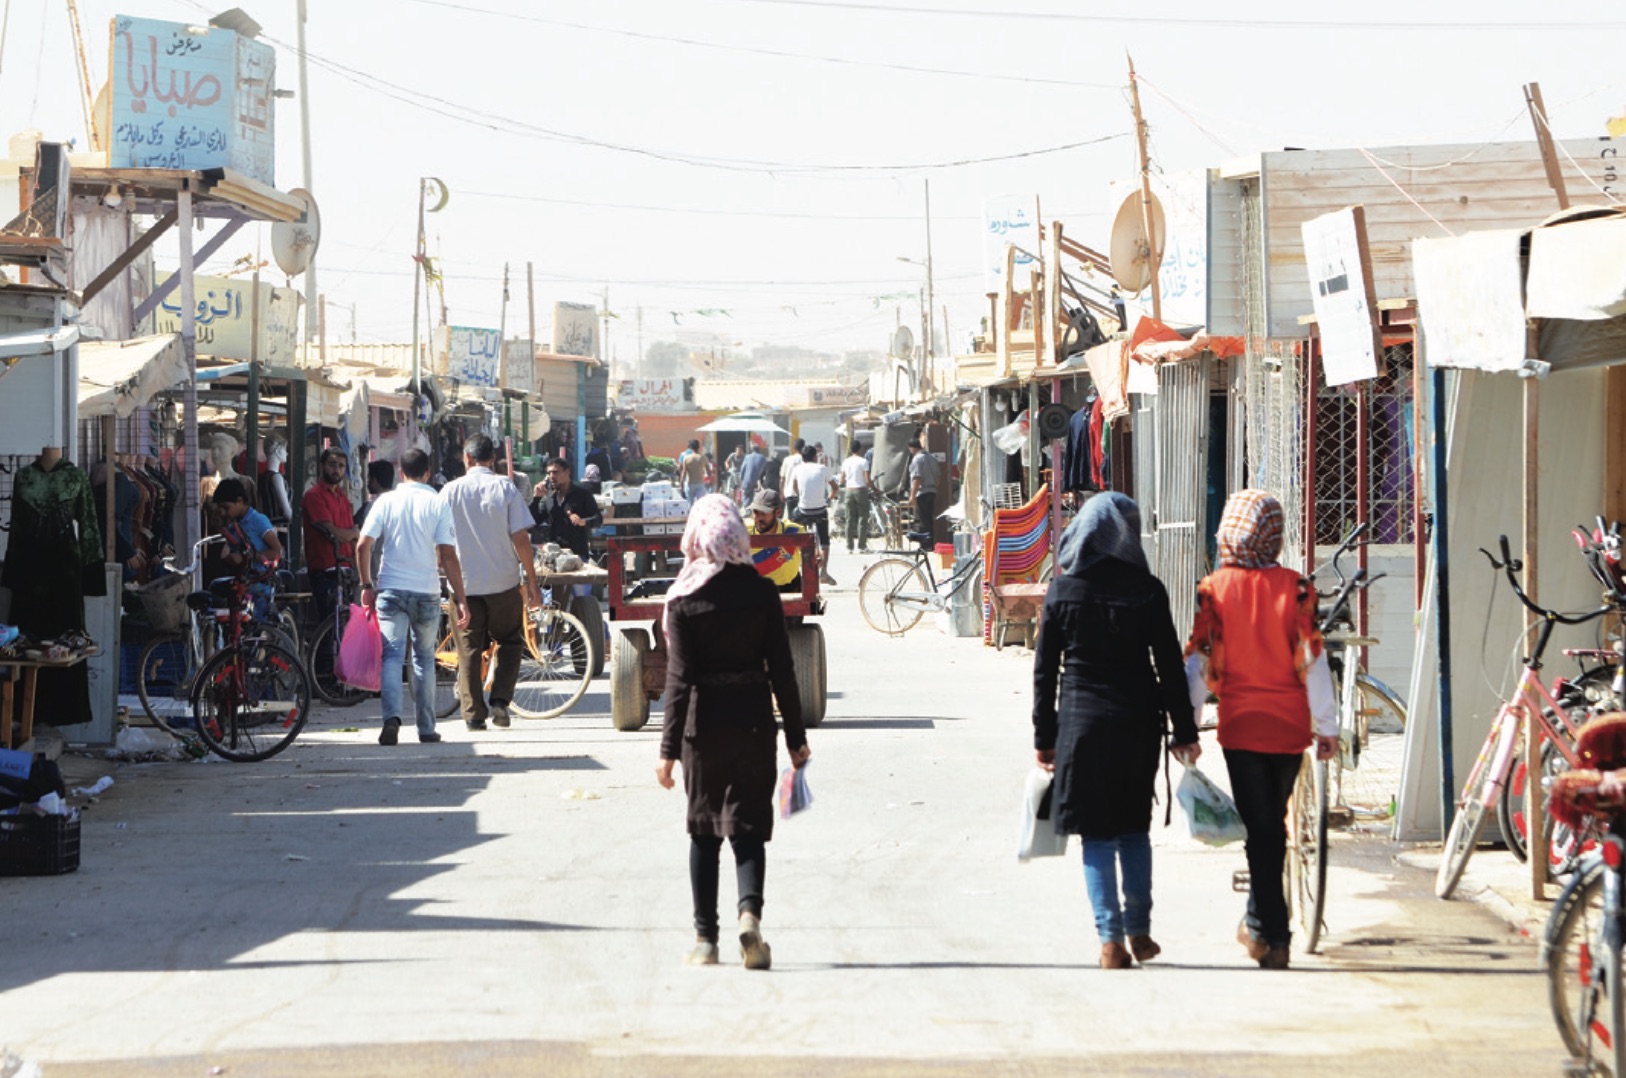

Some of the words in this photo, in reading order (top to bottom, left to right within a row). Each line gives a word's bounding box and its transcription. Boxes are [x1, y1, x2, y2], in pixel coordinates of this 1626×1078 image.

[165, 32, 202, 56] معرض
[124, 31, 222, 118] صبايا
[147, 121, 164, 145] وكل
